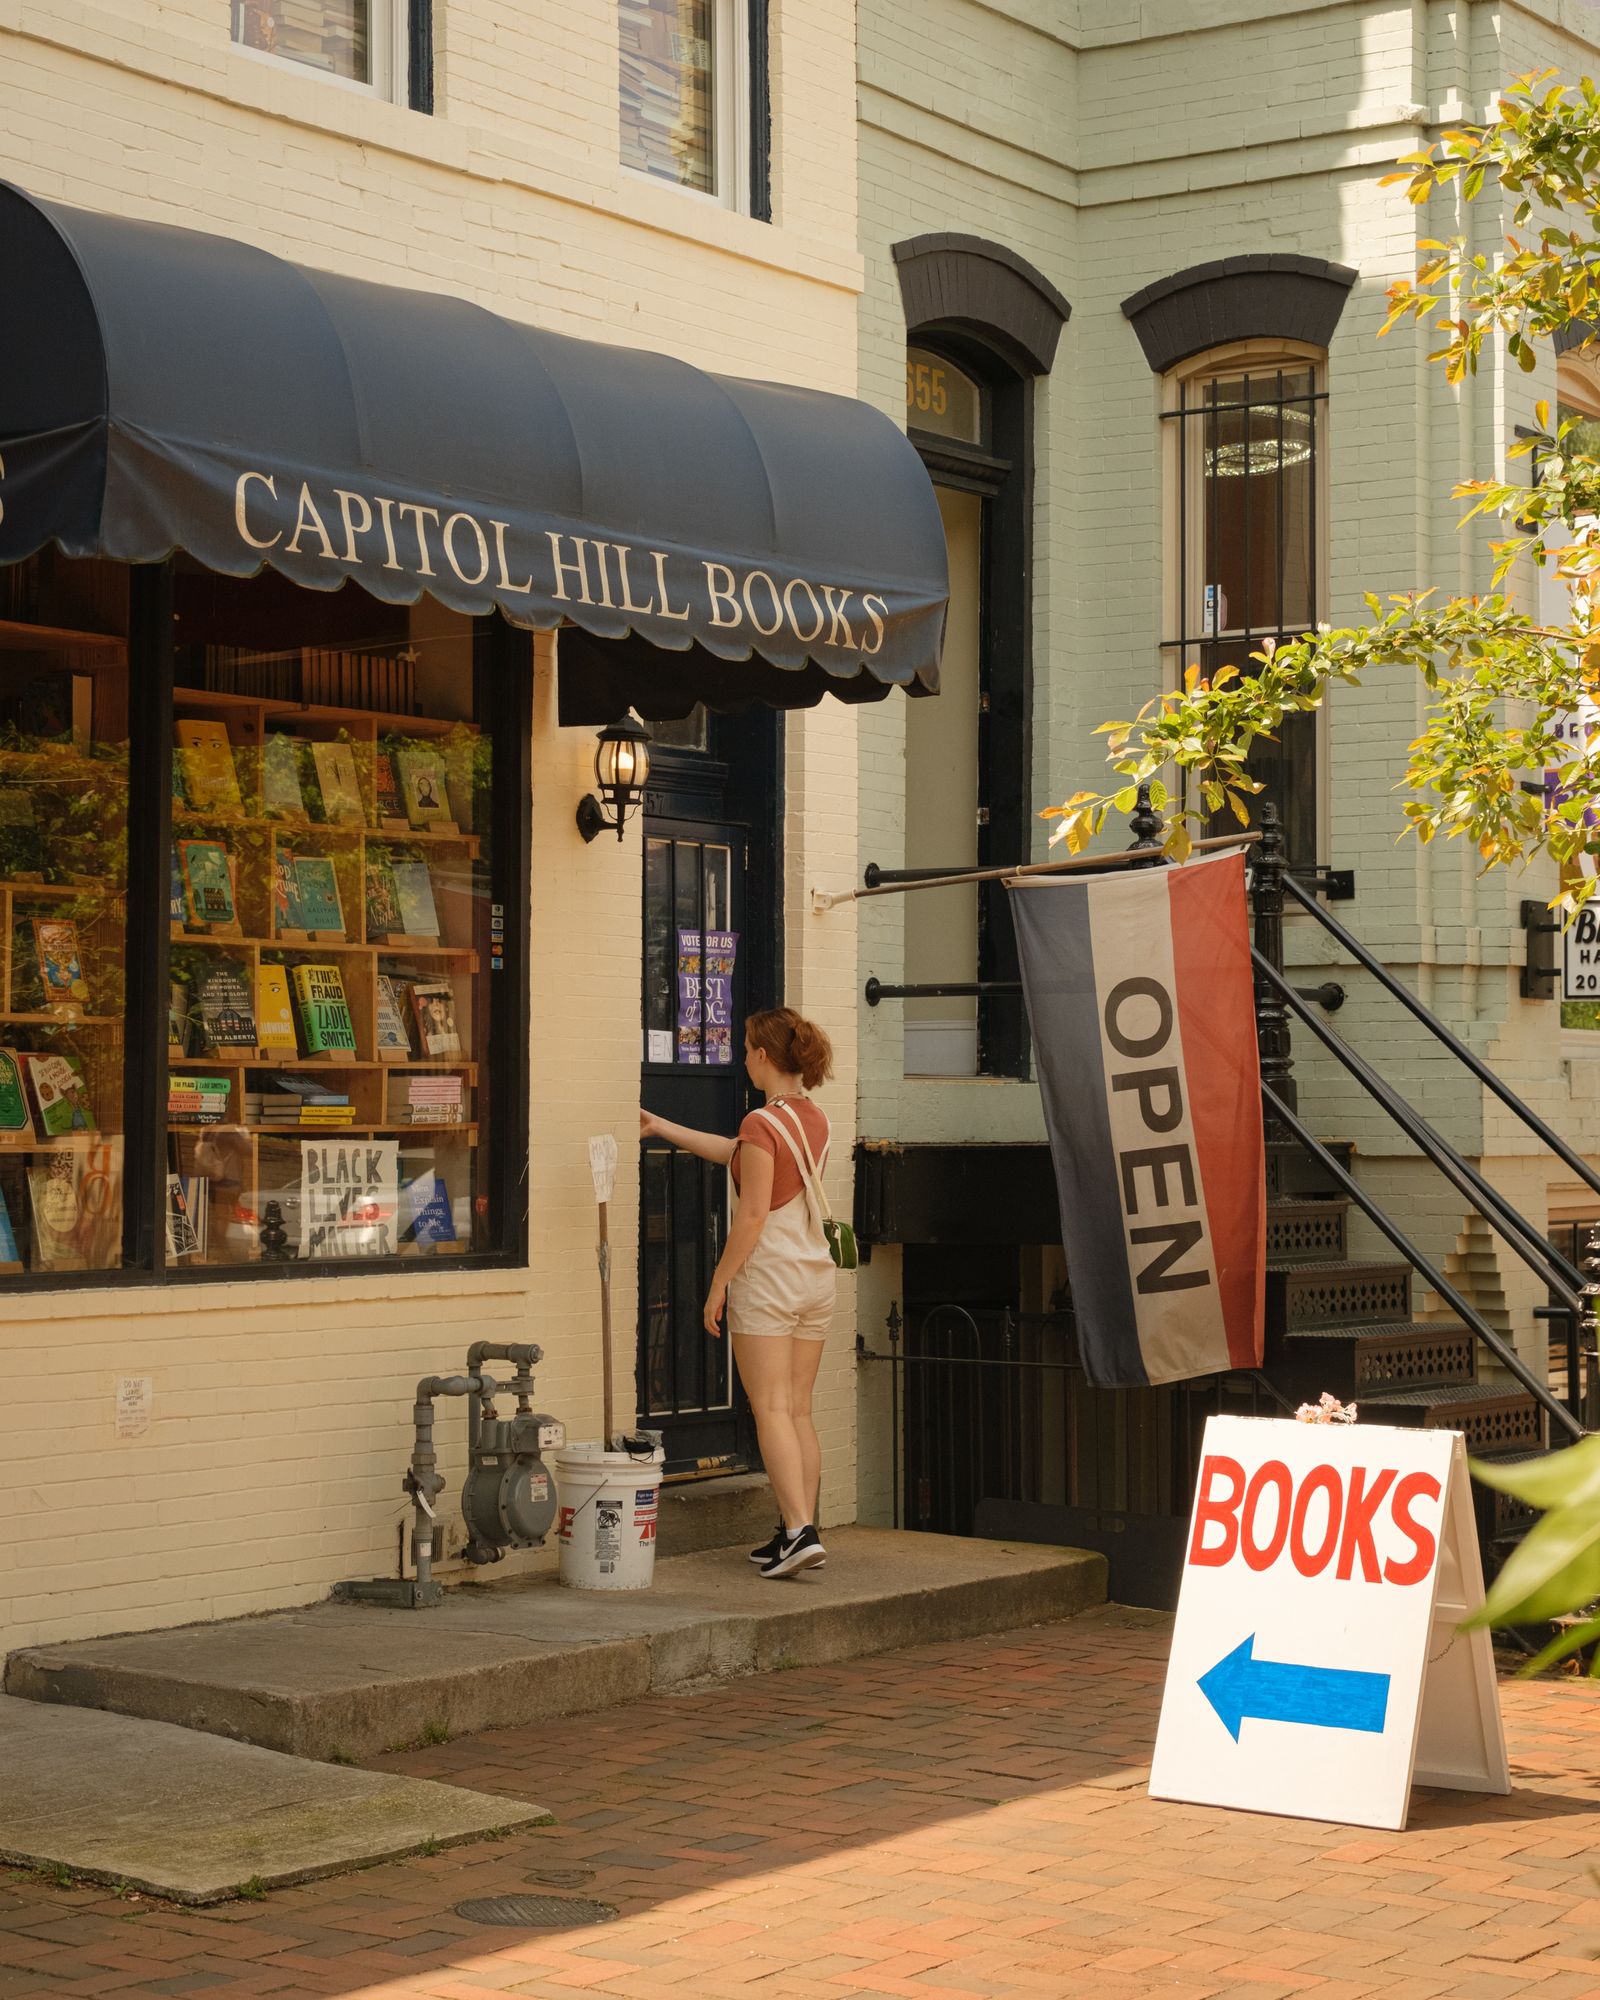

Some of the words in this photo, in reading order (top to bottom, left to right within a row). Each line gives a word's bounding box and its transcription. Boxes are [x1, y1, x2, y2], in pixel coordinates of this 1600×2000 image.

[236, 472, 532, 594] CAPITOL
[544, 532, 690, 620] HILL
[702, 561, 889, 655] BOOKS
[681, 935, 700, 946] VOTE
[720, 937, 733, 949] US
[314, 970, 333, 983] THE
[311, 984, 343, 999] FRAUD
[314, 1004, 350, 1029] ZADIE
[320, 1031, 354, 1047] SMITH
[1104, 976, 1211, 1295] OPEN
[307, 1148, 383, 1184] BLACK
[309, 1186, 380, 1223] LIVES
[415, 1207, 443, 1217] Things
[309, 1224, 390, 1258] MATTER
[1188, 1454, 1442, 1586] BOOKS
